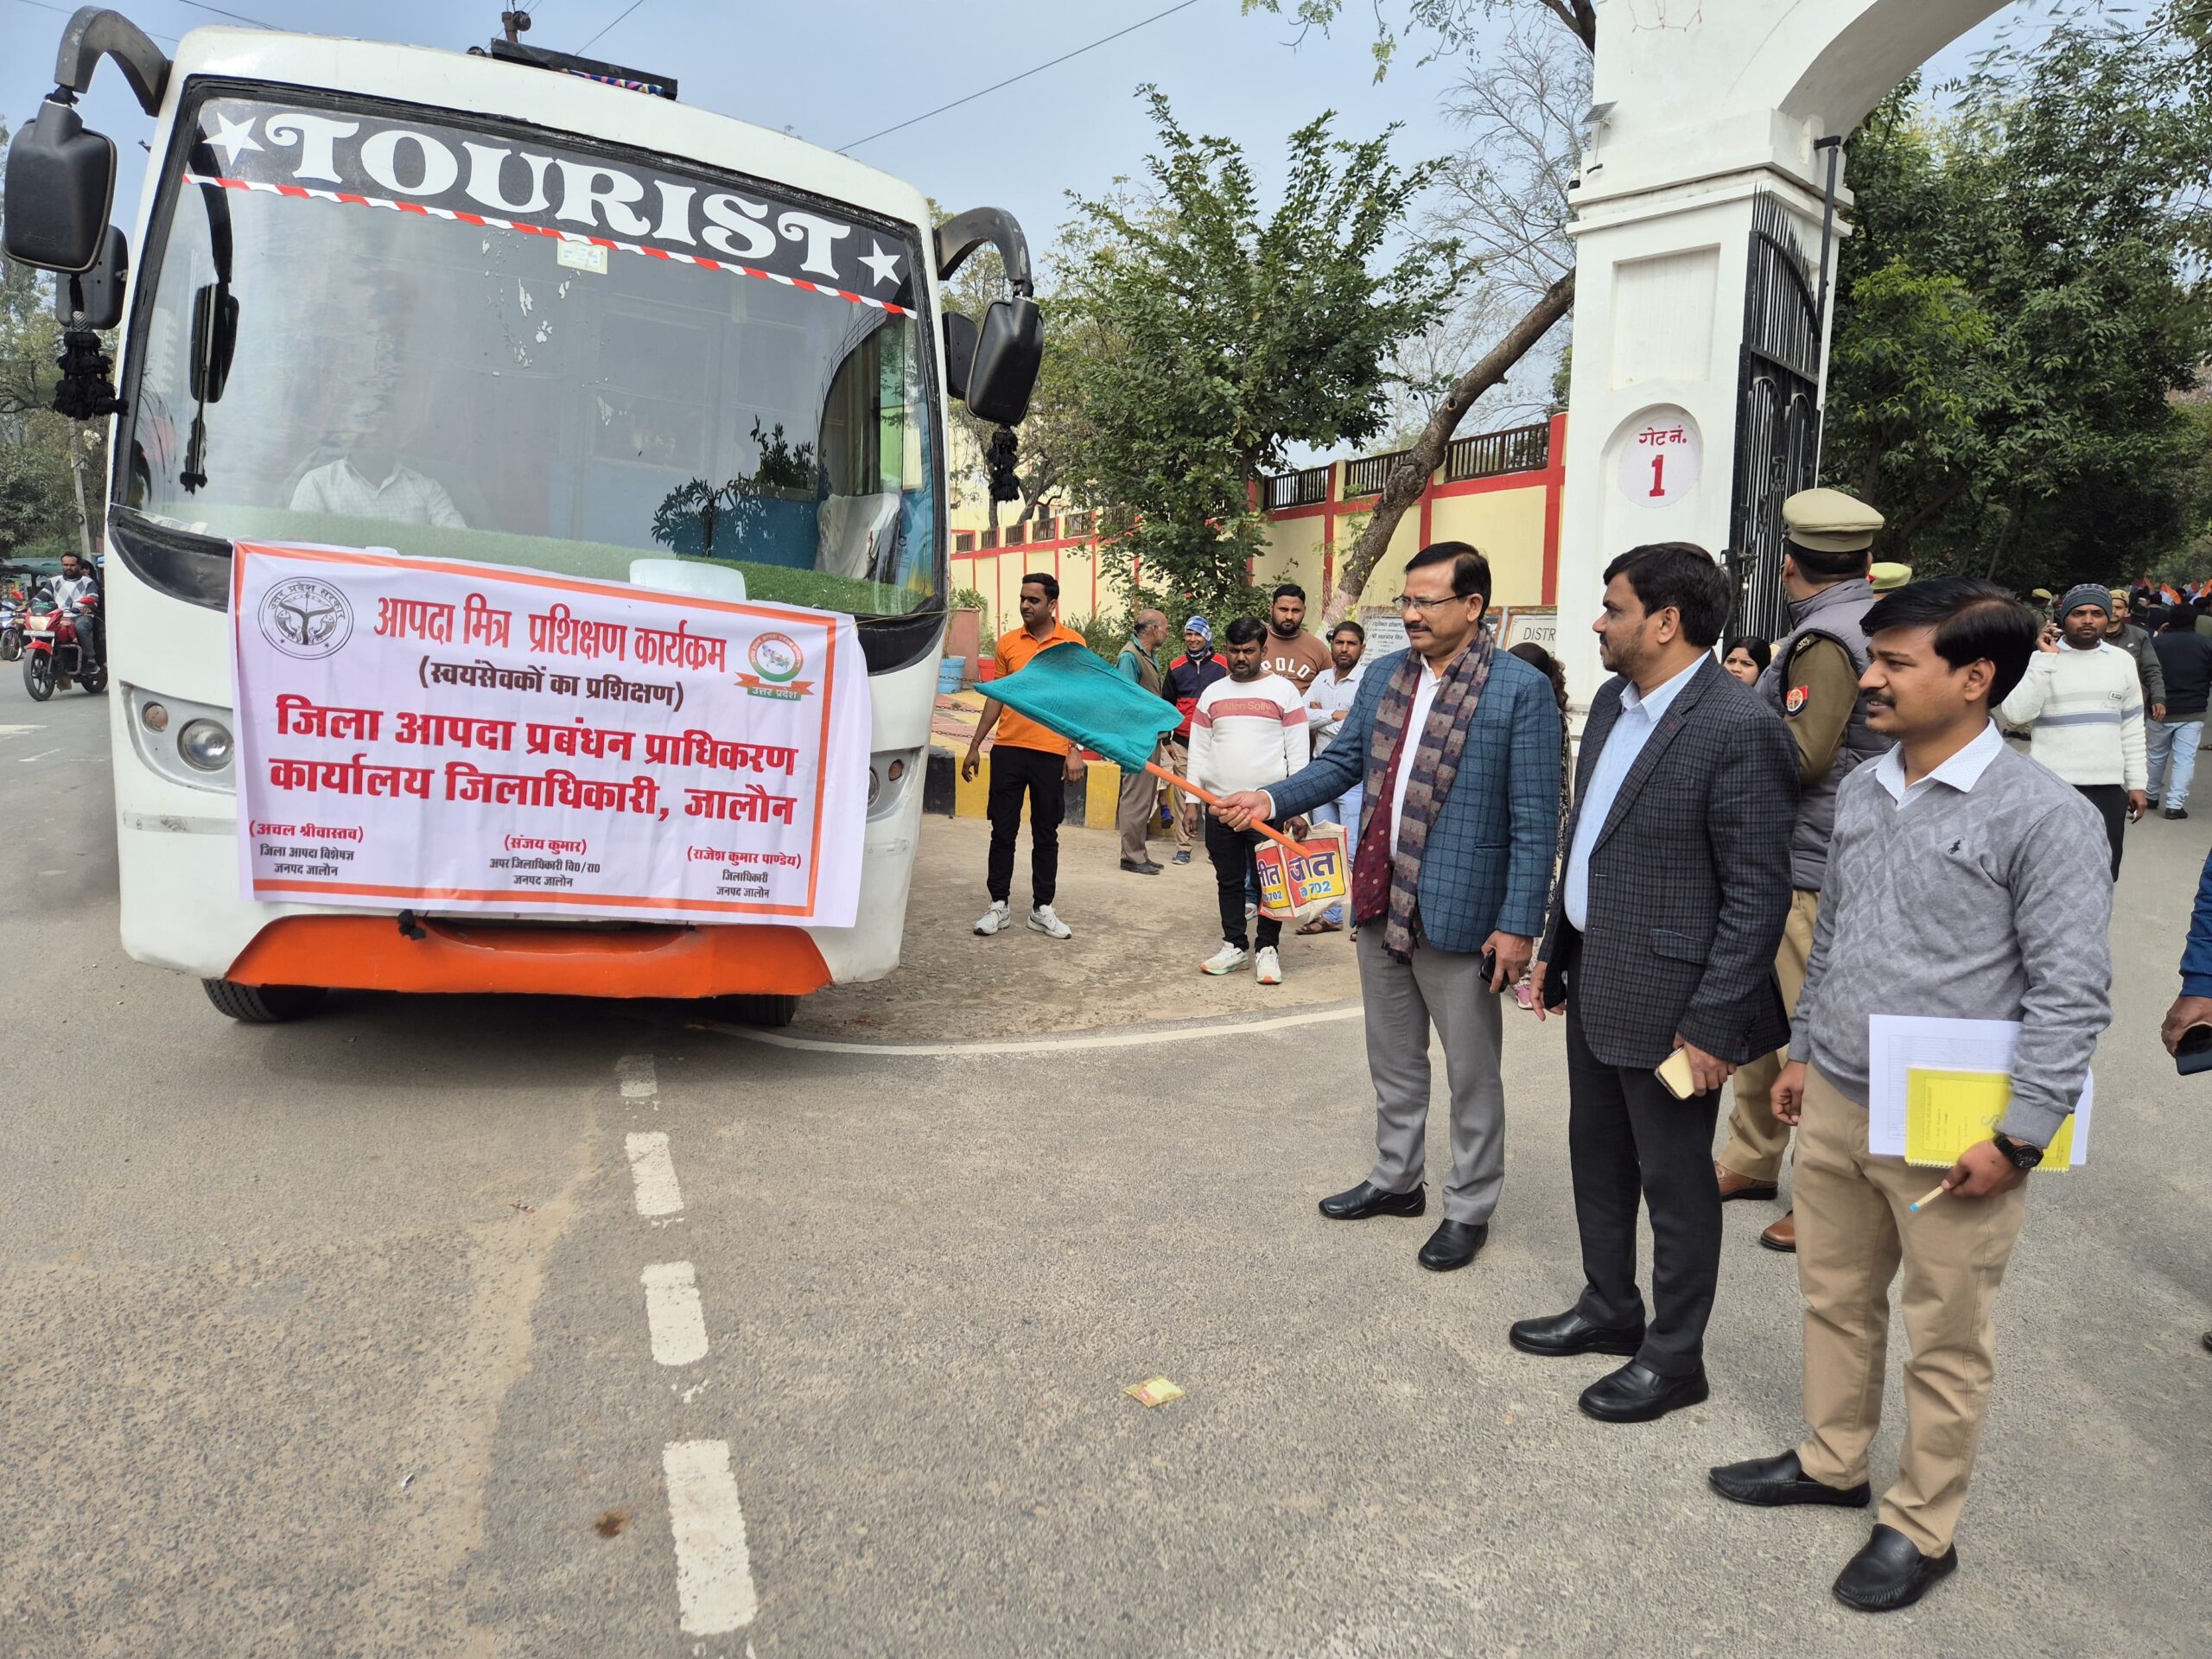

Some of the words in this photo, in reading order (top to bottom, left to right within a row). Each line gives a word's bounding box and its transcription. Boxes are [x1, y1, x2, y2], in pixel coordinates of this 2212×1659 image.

[264, 112, 851, 281] TOURIST
[1638, 427, 1668, 446] गेट
[1649, 454, 1665, 497] 1
[373, 596, 455, 645] आपदा
[462, 593, 512, 649] मित्र
[528, 603, 627, 661] प्रशिक्षण
[1522, 627, 1556, 641] DISTR
[1261, 657, 1311, 678] POLO
[550, 674, 581, 696] का
[586, 674, 683, 713] प्रशिक्षण)
[753, 687, 772, 696] उत्तर
[775, 687, 798, 699] प्रदेश
[1247, 701, 1271, 712] Solly
[276, 694, 384, 741] जिला
[395, 710, 518, 751] आपदा
[525, 716, 635, 761] प्रबंधन
[645, 729, 798, 775] प्राधिकरण
[269, 753, 435, 800] कार्यालय
[444, 761, 671, 822] जिलाधिकारी,
[684, 784, 798, 825] जालौन
[249, 820, 296, 838] (अचल
[300, 823, 364, 843] श्रीवास्तव)
[260, 843, 287, 857] जिला
[289, 847, 318, 859] आपदा
[505, 834, 545, 851] (संजय
[548, 838, 588, 855] कुमार)
[489, 858, 510, 869] अपर
[512, 856, 563, 871] जिलाधिकारी
[687, 846, 726, 861] (राजेश
[728, 851, 760, 867] कुमार
[762, 852, 801, 869] पाण्डेय)
[274, 863, 303, 874] जनपद
[722, 869, 768, 883] जिलाधिकारी
[513, 874, 542, 886] जनपद
[716, 886, 741, 897] जनपद
